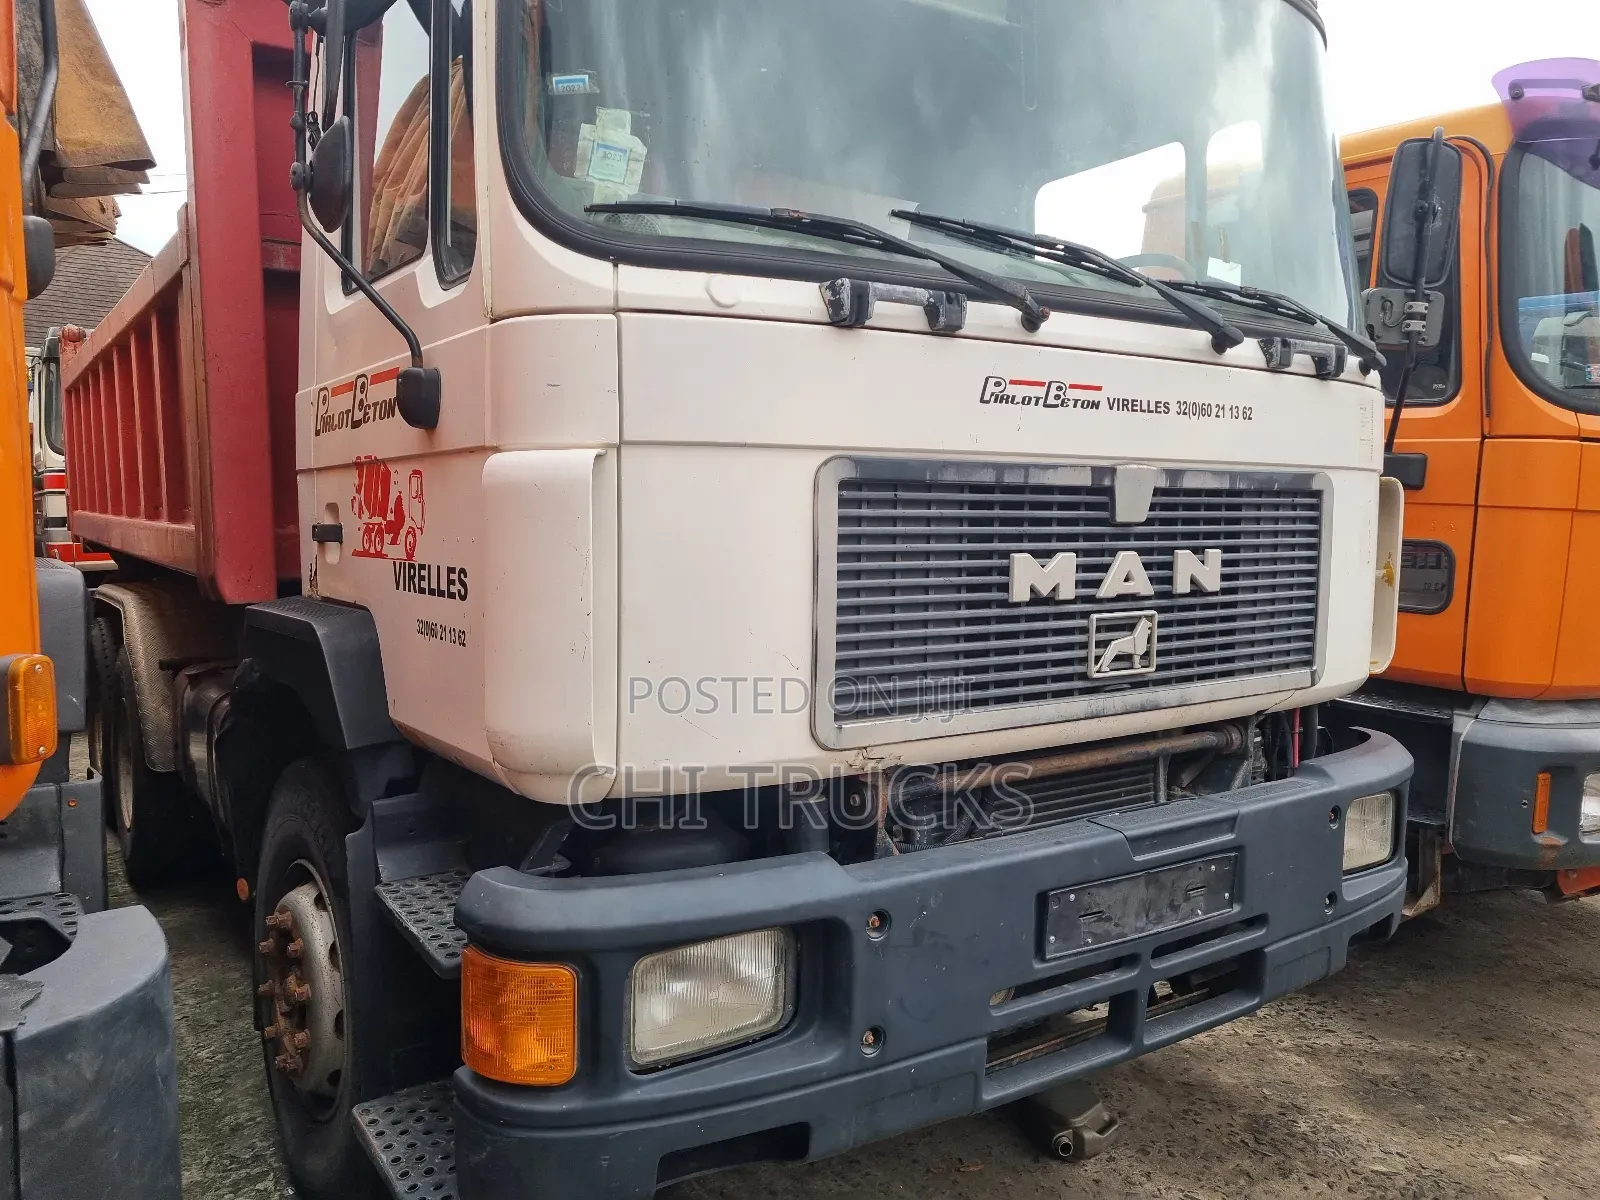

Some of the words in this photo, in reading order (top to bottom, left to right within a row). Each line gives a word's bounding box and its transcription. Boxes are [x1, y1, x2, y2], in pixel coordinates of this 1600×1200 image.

[1043, 380, 1101, 410] BETON
[1106, 396, 1170, 414] VIRELLES
[1176, 400, 1212, 420] 32(0)60
[1215, 403, 1225, 418] 21
[1229, 404, 1240, 419] 13
[1242, 406, 1253, 420] 62
[393, 560, 468, 602] VIRELLES
[1009, 548, 1222, 603] MAN
[440, 624, 447, 641] 21
[449, 626, 456, 645] 13
[458, 628, 466, 647] 62
